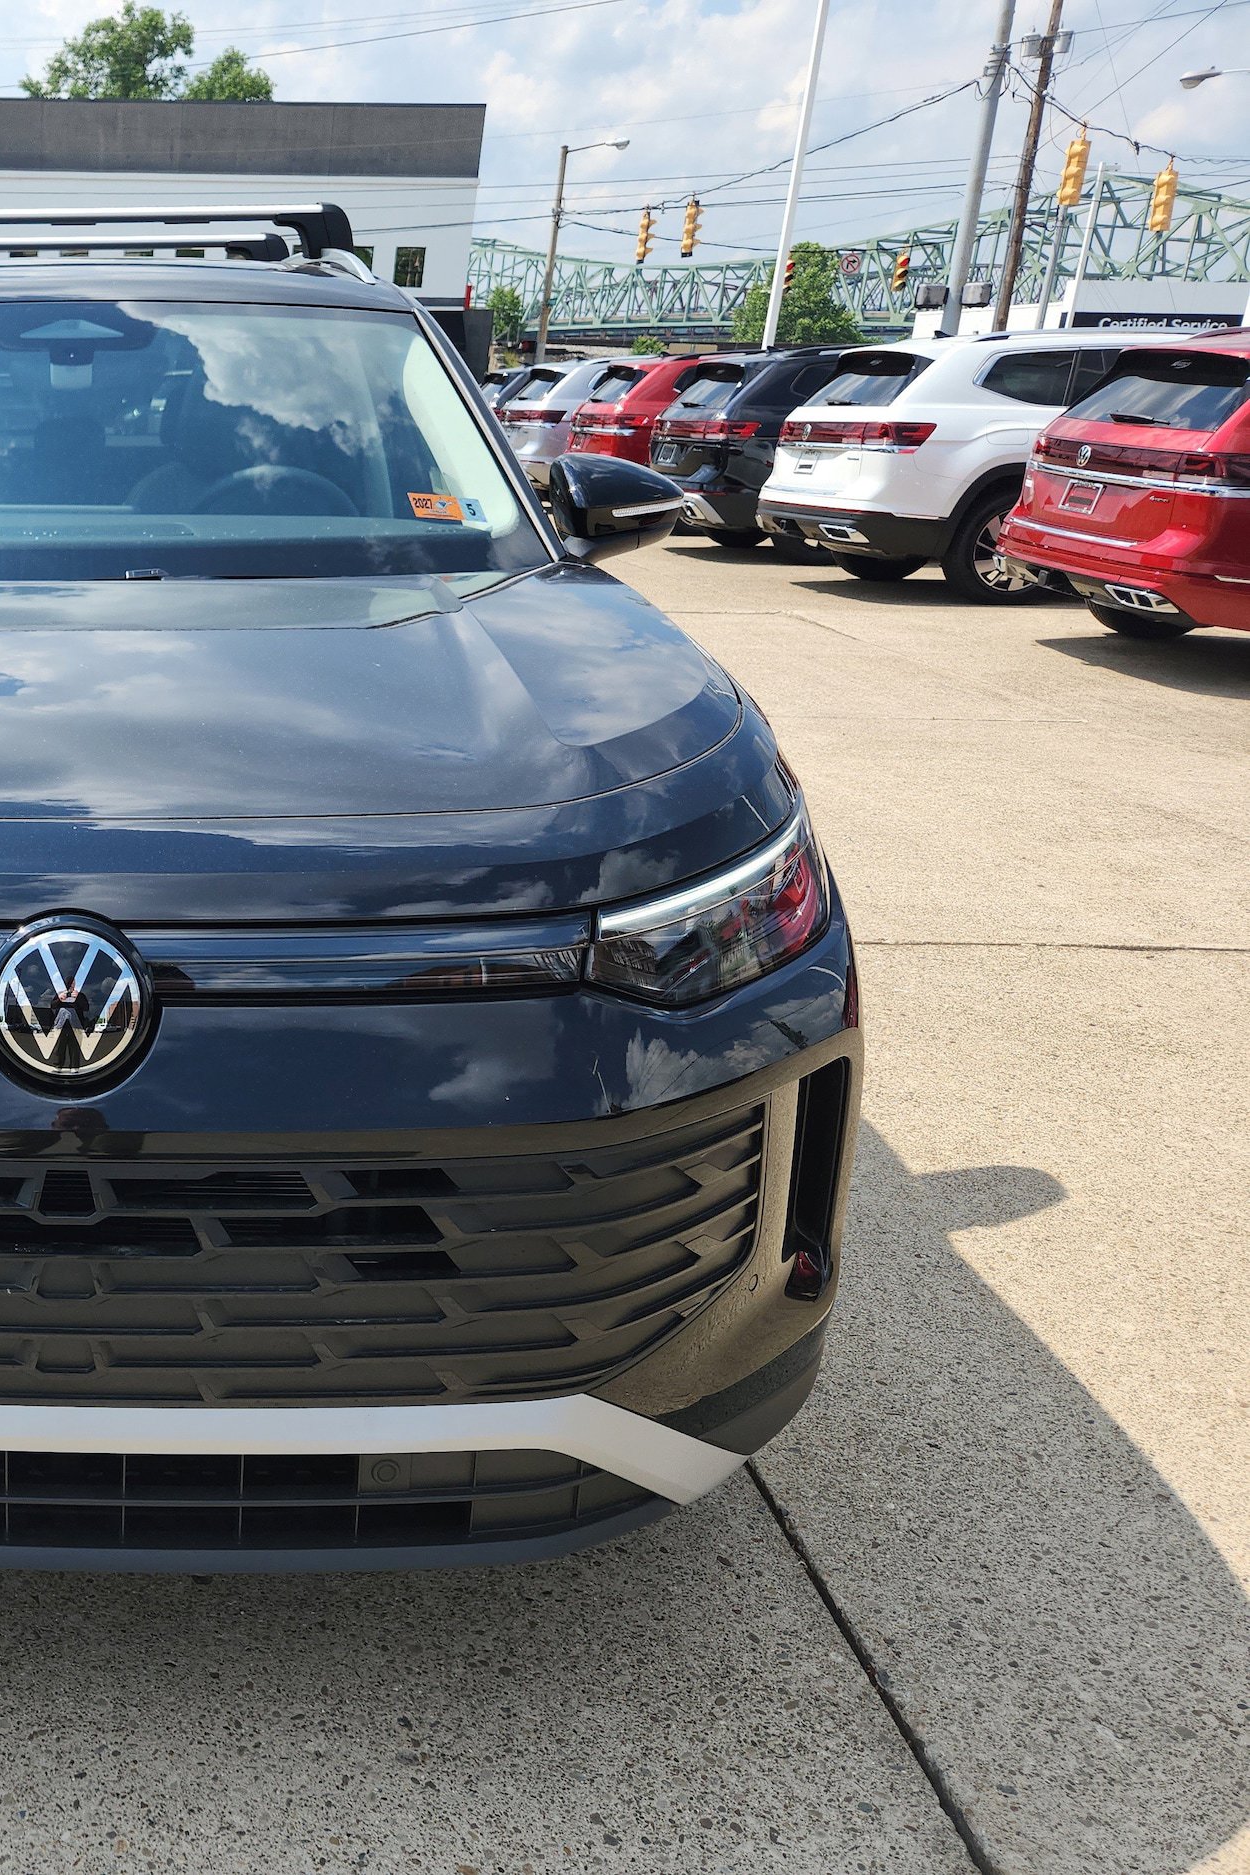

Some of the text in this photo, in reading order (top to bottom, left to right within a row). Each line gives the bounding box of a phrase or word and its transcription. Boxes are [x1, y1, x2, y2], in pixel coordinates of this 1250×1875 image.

[1098, 317, 1227, 329] Certified Service
[413, 498, 433, 509] 2027
[466, 504, 476, 516] 5
